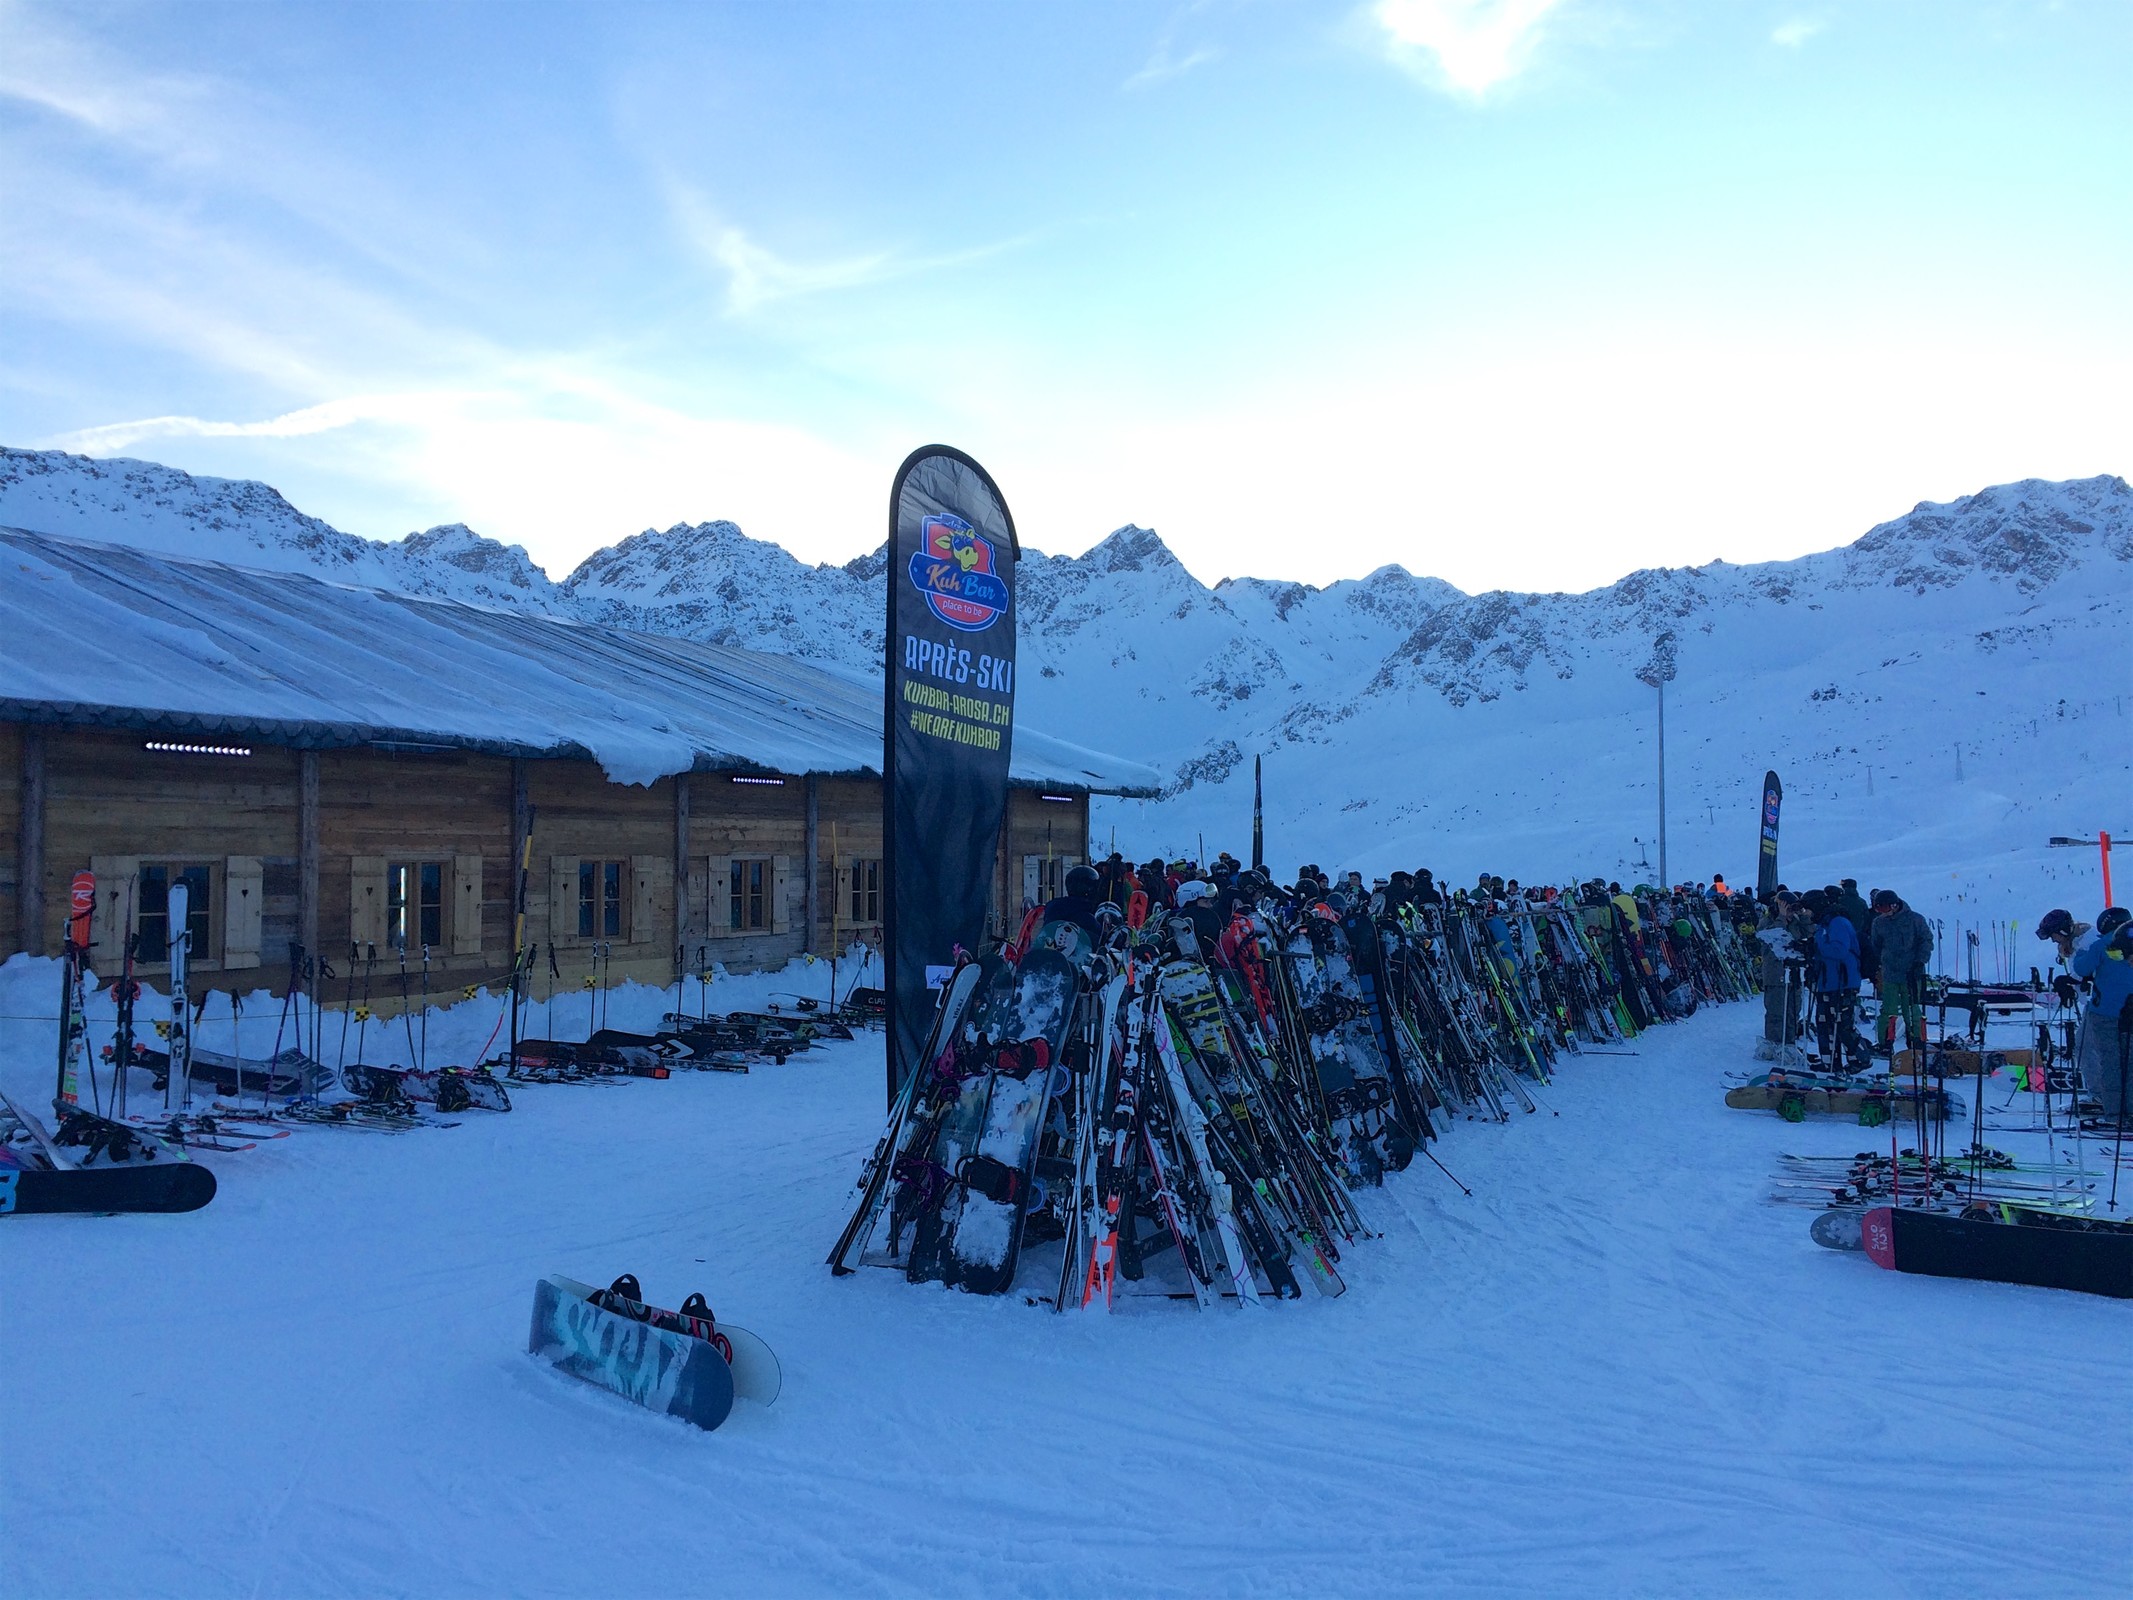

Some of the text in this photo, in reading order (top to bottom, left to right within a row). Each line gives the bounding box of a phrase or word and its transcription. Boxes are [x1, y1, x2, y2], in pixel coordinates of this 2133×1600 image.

[926, 563, 995, 600] Kuh Bar
[942, 600, 982, 617] place to be
[905, 635, 1012, 693] APRÈS-SKI
[904, 680, 1010, 726] KUHBAR-AROSA.CH
